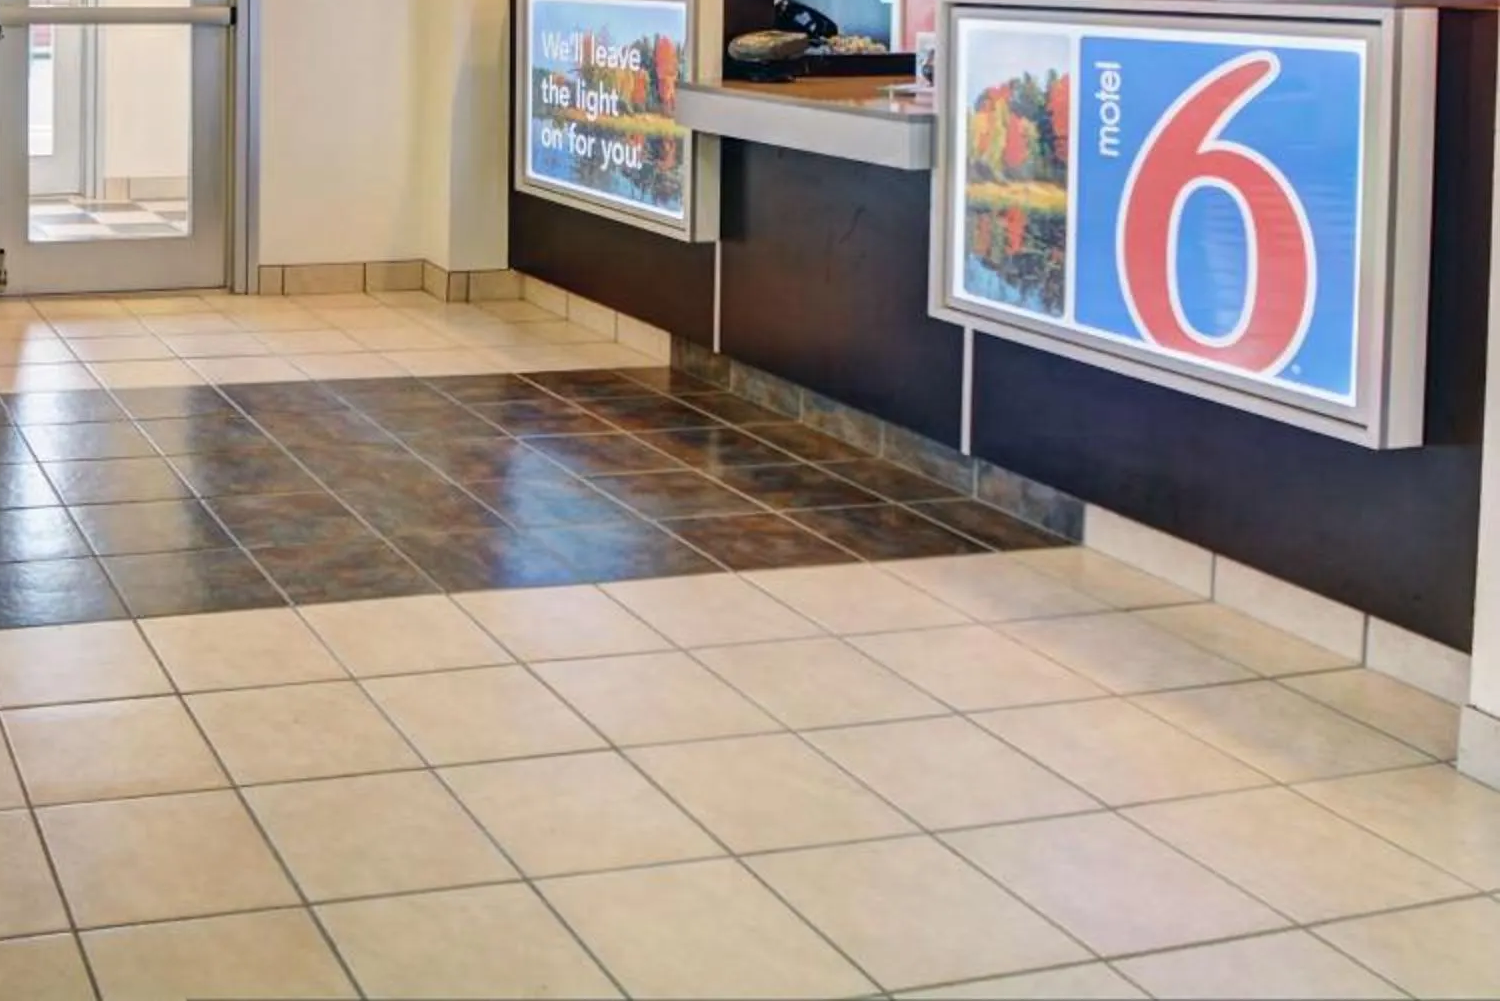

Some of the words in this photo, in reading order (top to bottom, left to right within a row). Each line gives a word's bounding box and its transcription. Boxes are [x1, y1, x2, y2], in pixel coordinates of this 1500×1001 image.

[541, 31, 584, 66] We'll
[590, 30, 641, 71] leave
[541, 74, 571, 106] the
[576, 77, 619, 122] light
[541, 126, 563, 149] on
[567, 123, 596, 157] for
[1094, 60, 1122, 159] motel
[1115, 49, 1317, 377] 6
